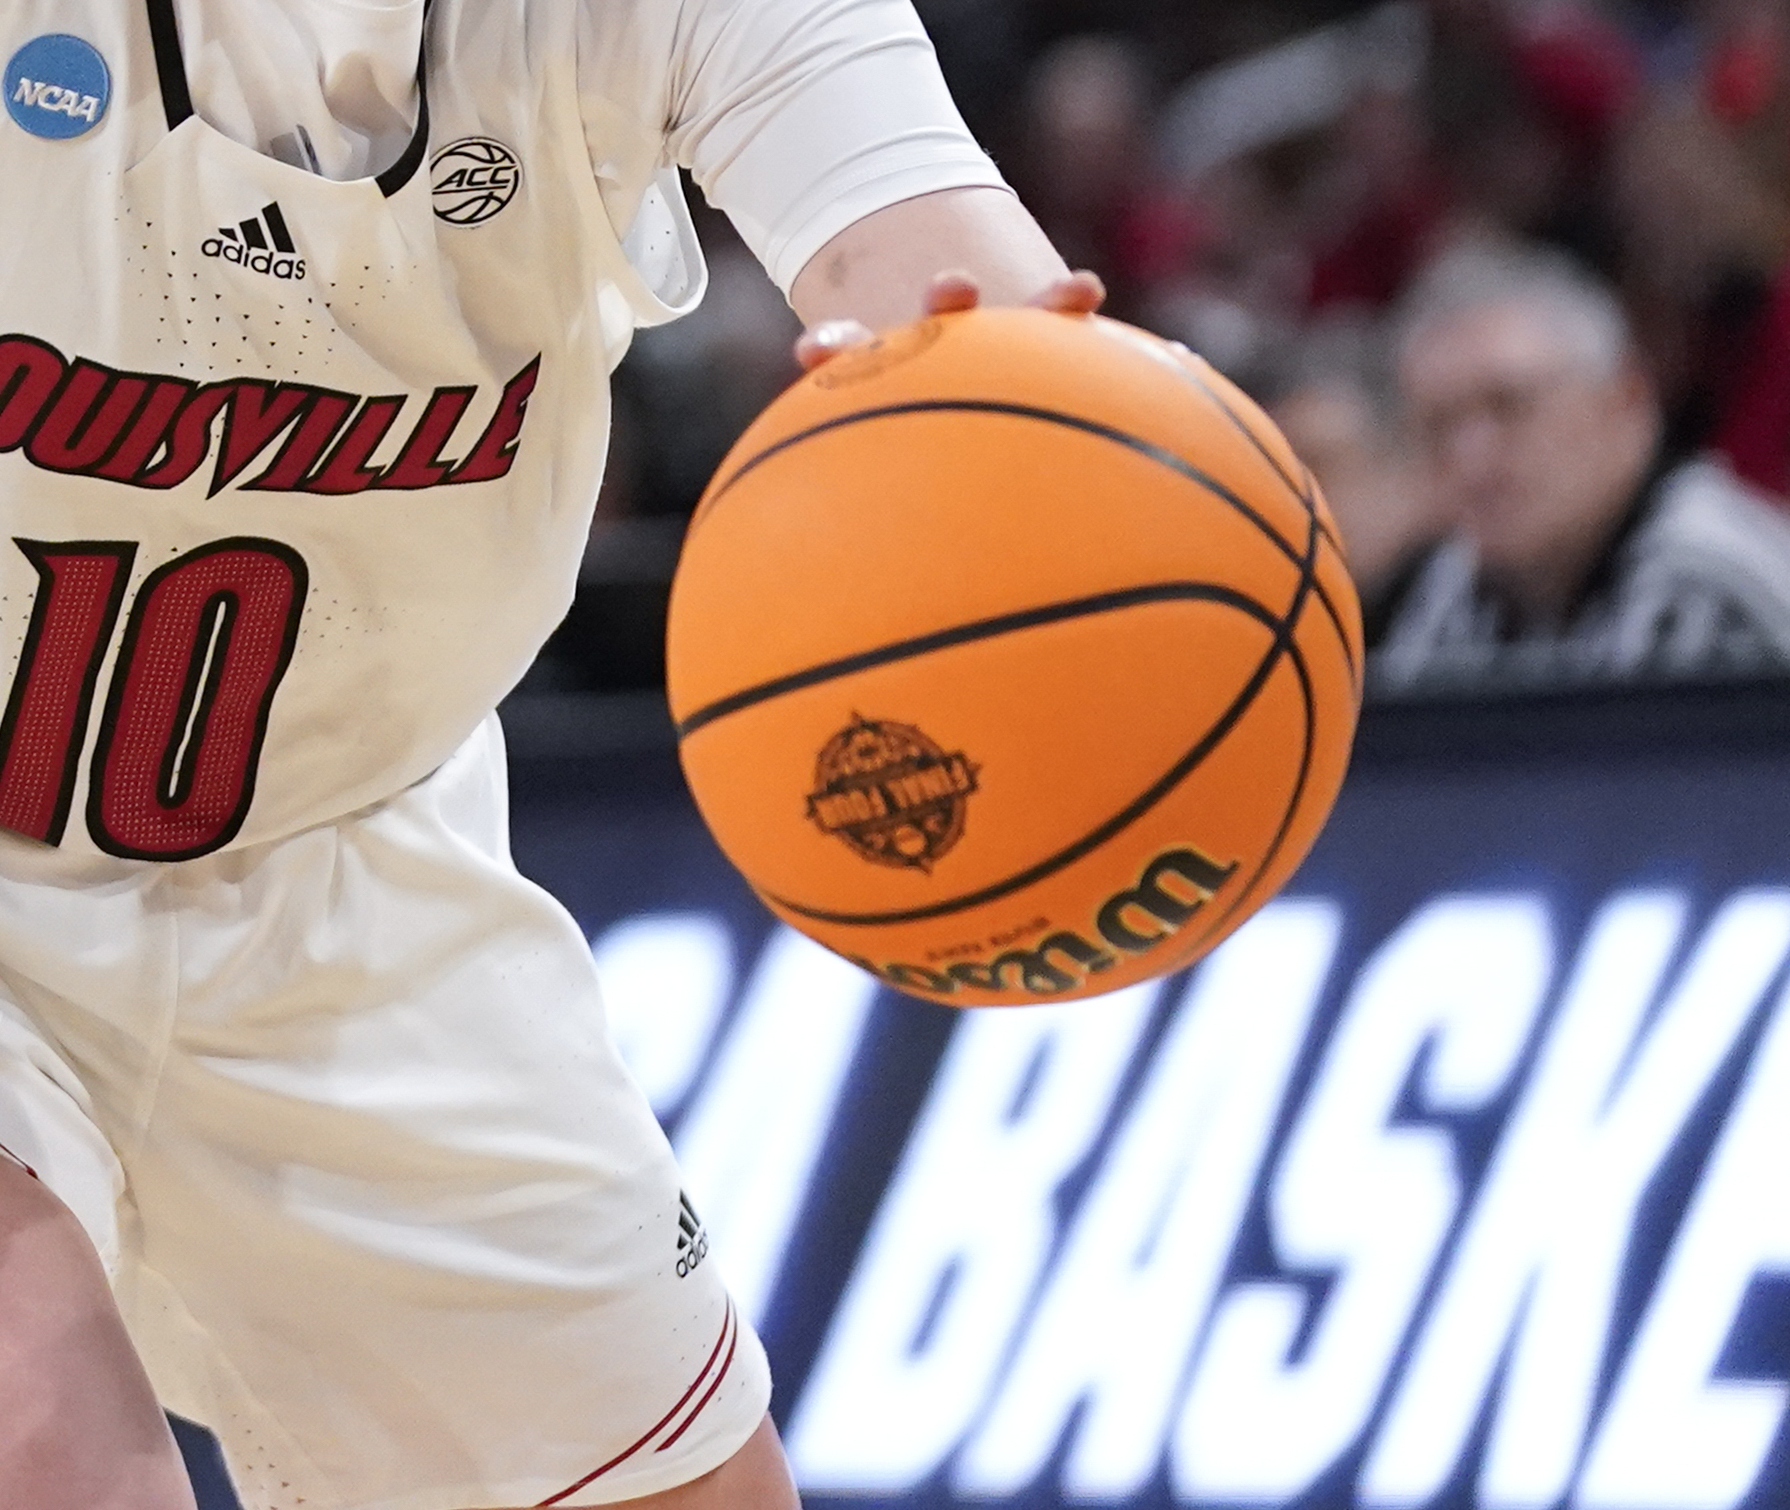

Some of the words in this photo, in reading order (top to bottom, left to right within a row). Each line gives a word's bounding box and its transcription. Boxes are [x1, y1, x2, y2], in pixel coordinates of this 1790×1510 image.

[12, 76, 101, 122] NCAA
[433, 165, 518, 190] ACC
[201, 238, 307, 280] adidas
[886, 755, 971, 810] FINAL
[811, 786, 887, 830] FOUR
